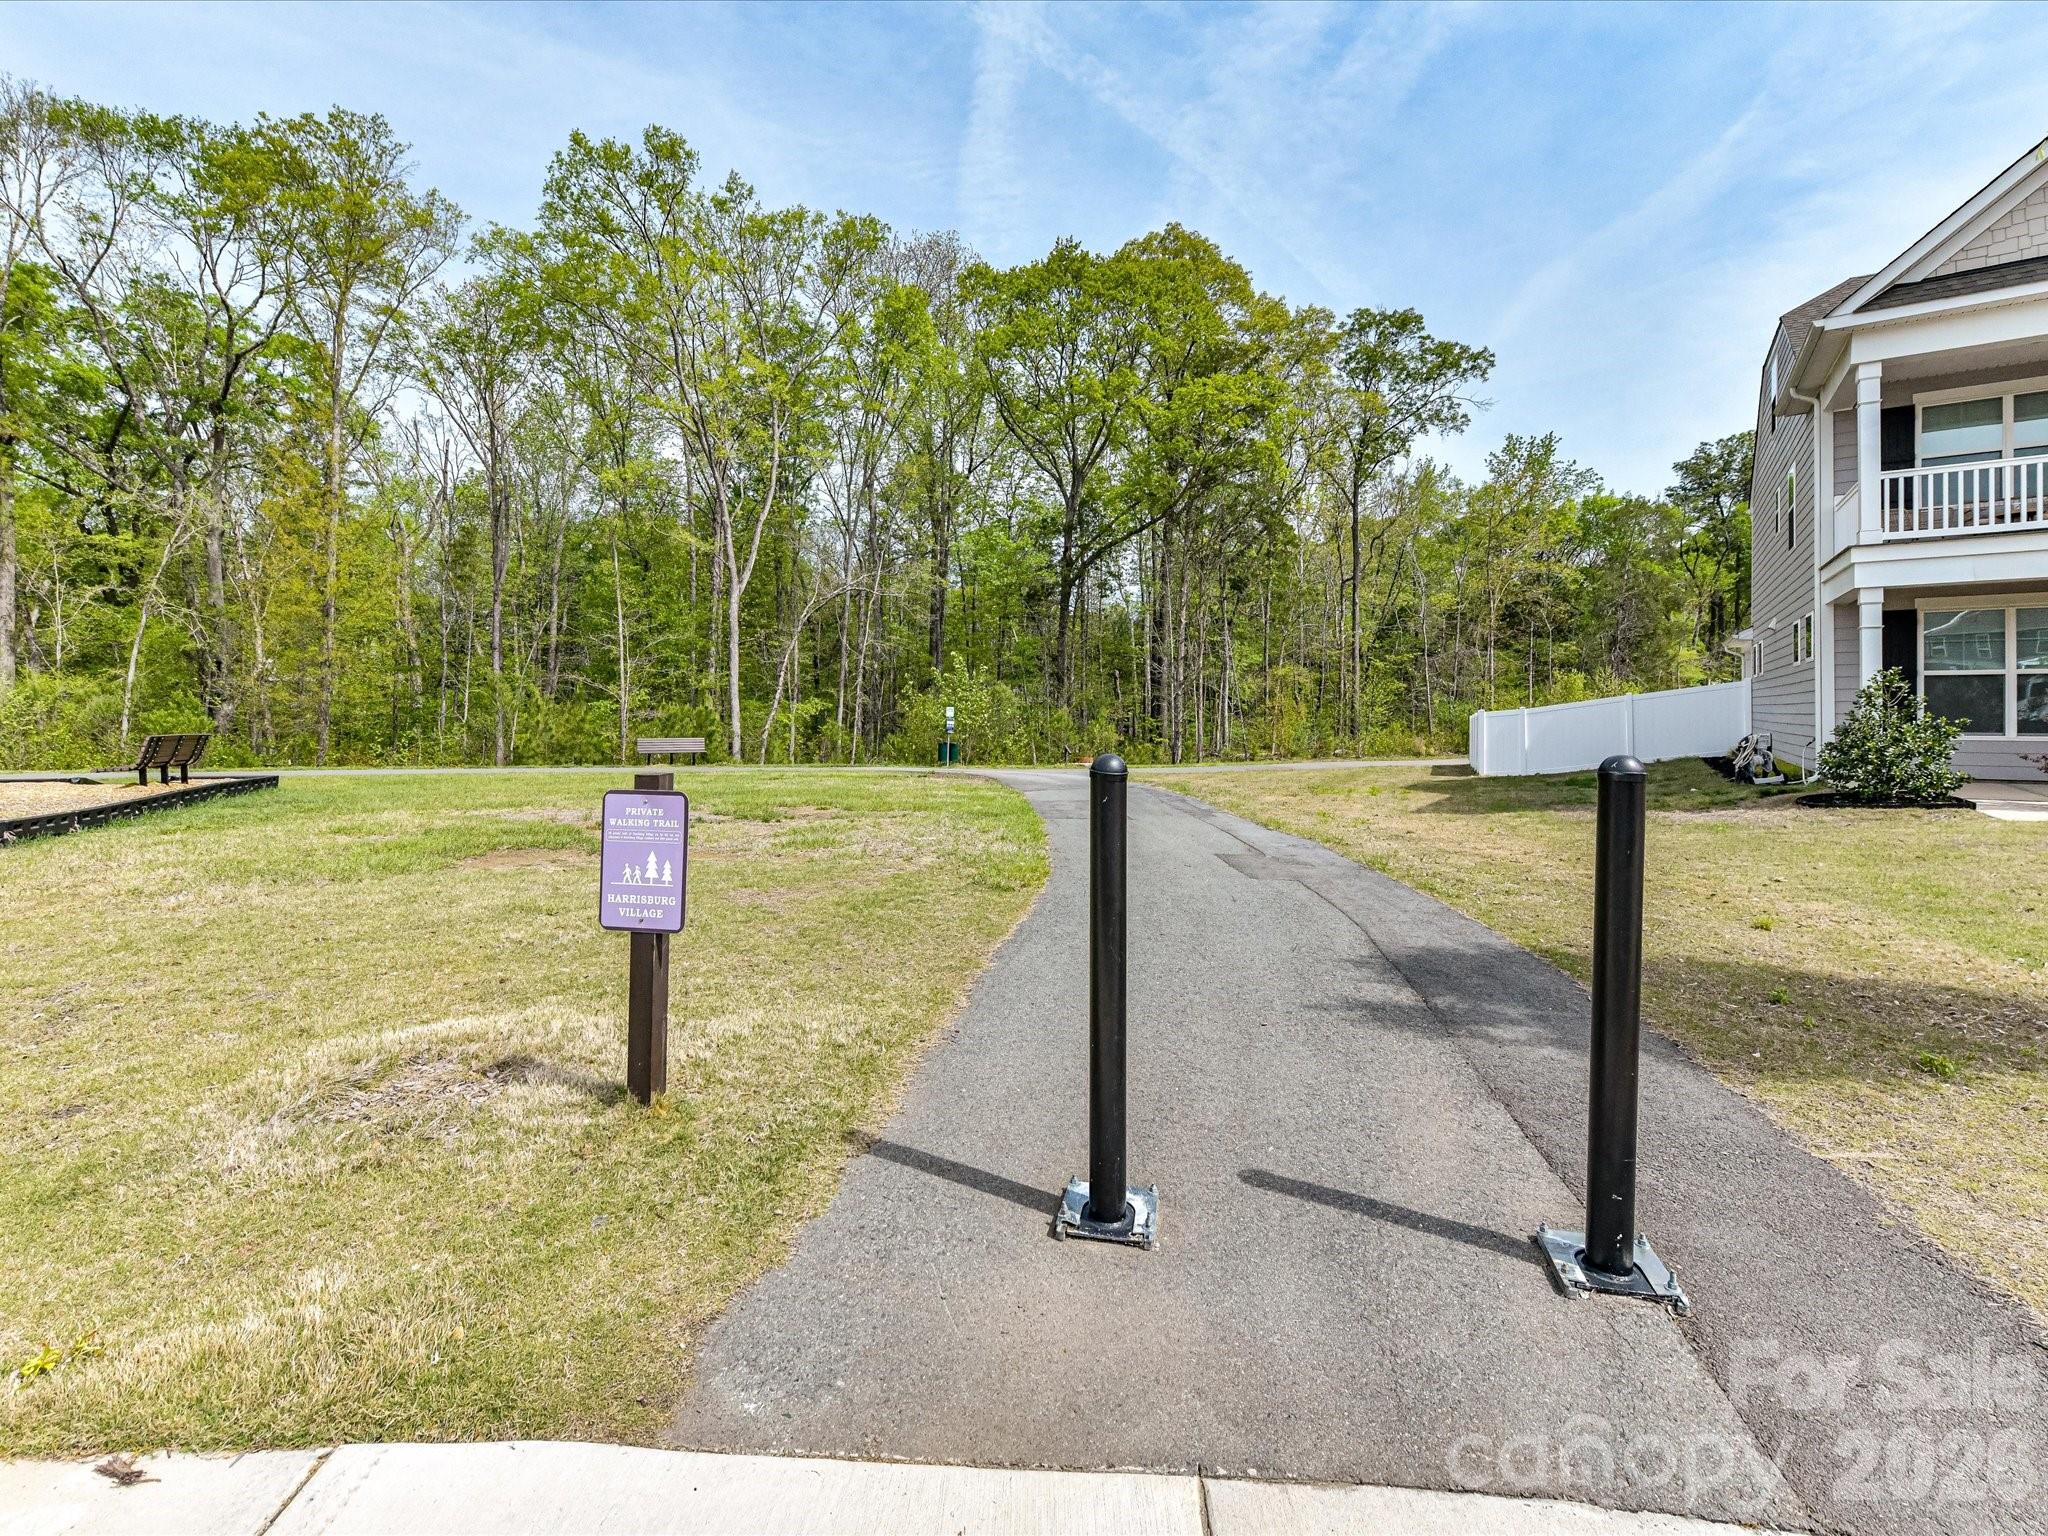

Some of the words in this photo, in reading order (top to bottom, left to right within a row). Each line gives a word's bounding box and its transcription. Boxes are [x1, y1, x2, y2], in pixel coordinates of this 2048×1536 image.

[625, 807, 664, 816] PRIVATE
[609, 818, 650, 827] WALKING
[653, 819, 680, 828] TRAIL
[607, 893, 677, 906] HARRISBURG
[618, 907, 664, 919] VILLAGE
